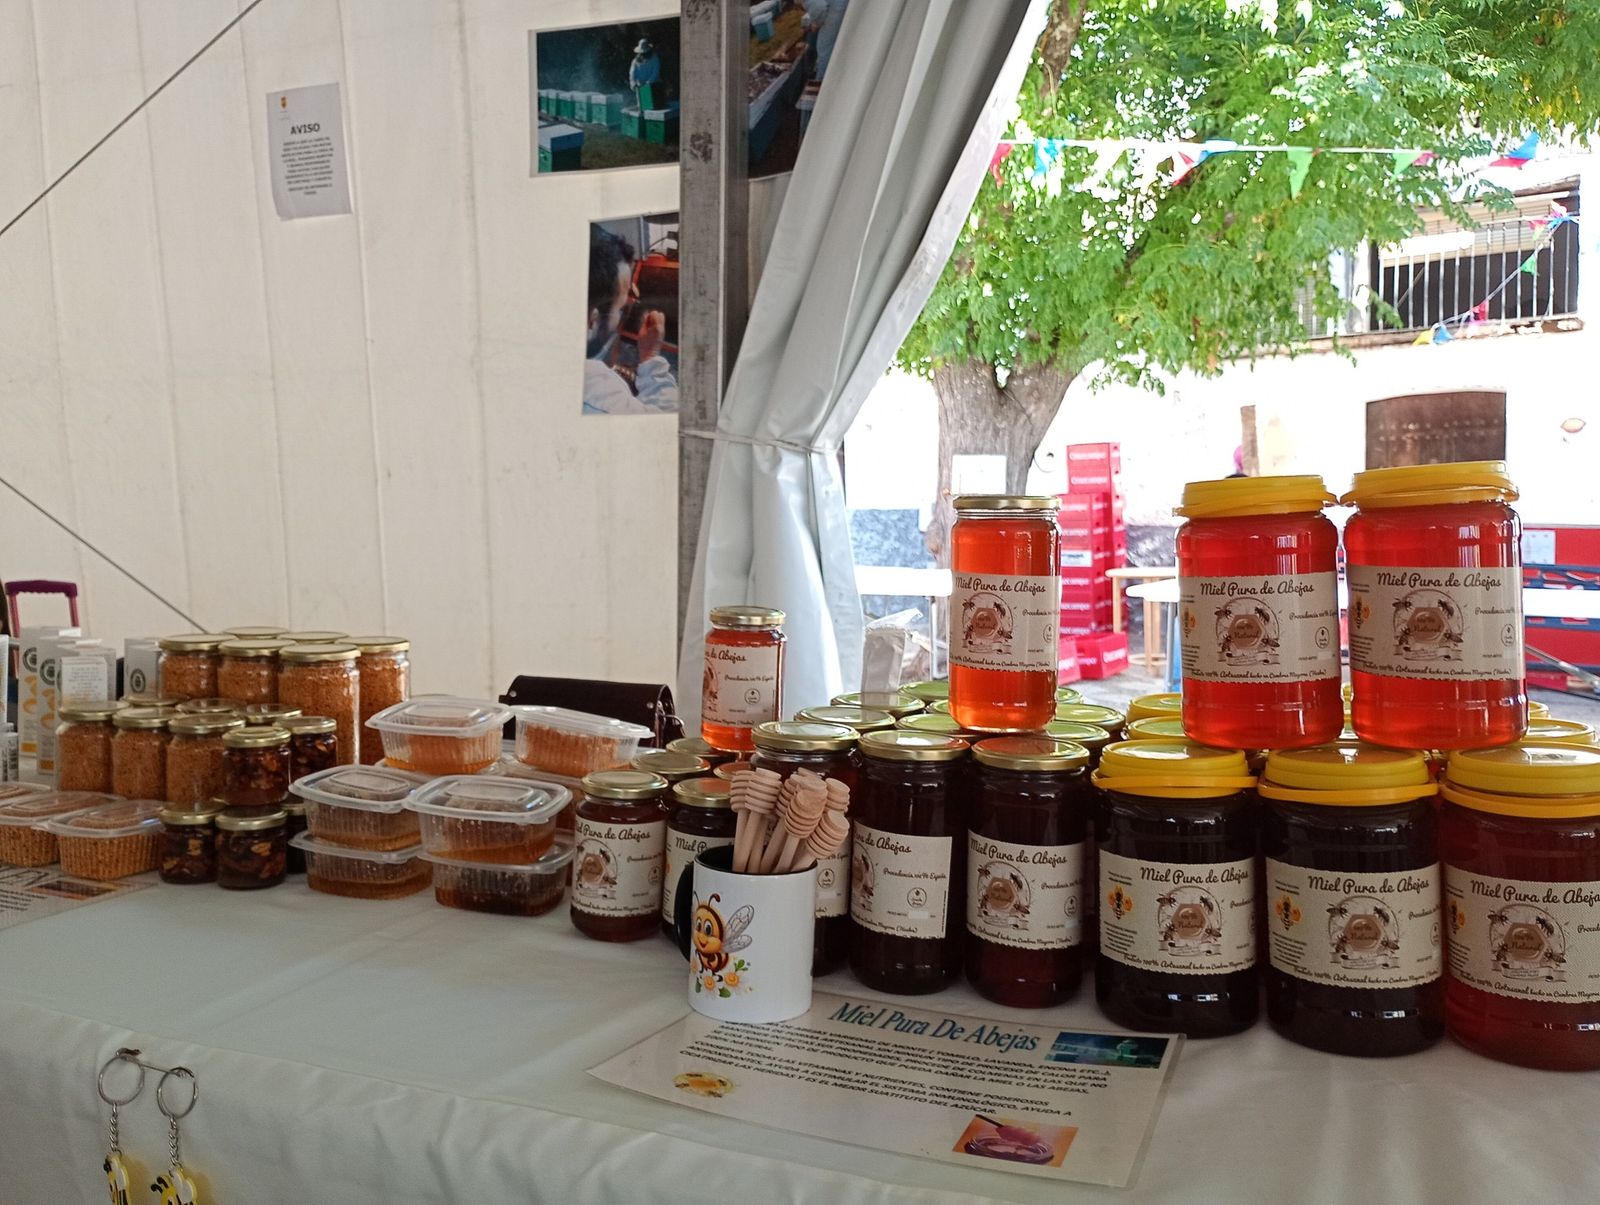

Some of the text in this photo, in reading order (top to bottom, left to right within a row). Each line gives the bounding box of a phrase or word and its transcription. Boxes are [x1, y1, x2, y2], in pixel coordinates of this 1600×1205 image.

[290, 123, 320, 135] AVISO
[956, 577, 972, 588] Miel
[973, 578, 997, 591] Pura
[1000, 579, 1012, 592] de
[1014, 579, 1046, 596] Abejas
[1200, 580, 1314, 597] Miel Pura de Abejas
[1376, 572, 1502, 590] Miel Pura de Abejas
[718, 650, 747, 664] Abejas
[583, 824, 651, 842] Pura de Abejas
[676, 836, 696, 852] Miel
[865, 833, 912, 855] de Abejas
[970, 838, 1067, 868] Miel Pura de Abejas
[1140, 866, 1171, 882] Miel
[1172, 870, 1203, 885] Pura
[1205, 869, 1219, 884] de
[1220, 866, 1249, 884] Abejas
[1307, 875, 1341, 892] Miel
[1343, 878, 1377, 894] Pura
[1379, 878, 1394, 893] de
[1397, 876, 1430, 894] Abejas
[1470, 880, 1501, 898] Miel
[1503, 885, 1540, 902] Pura
[1542, 888, 1560, 903] de
[1563, 888, 1600, 907] Abeja
[828, 1002, 1041, 1054] Miel Pura De Abejas
